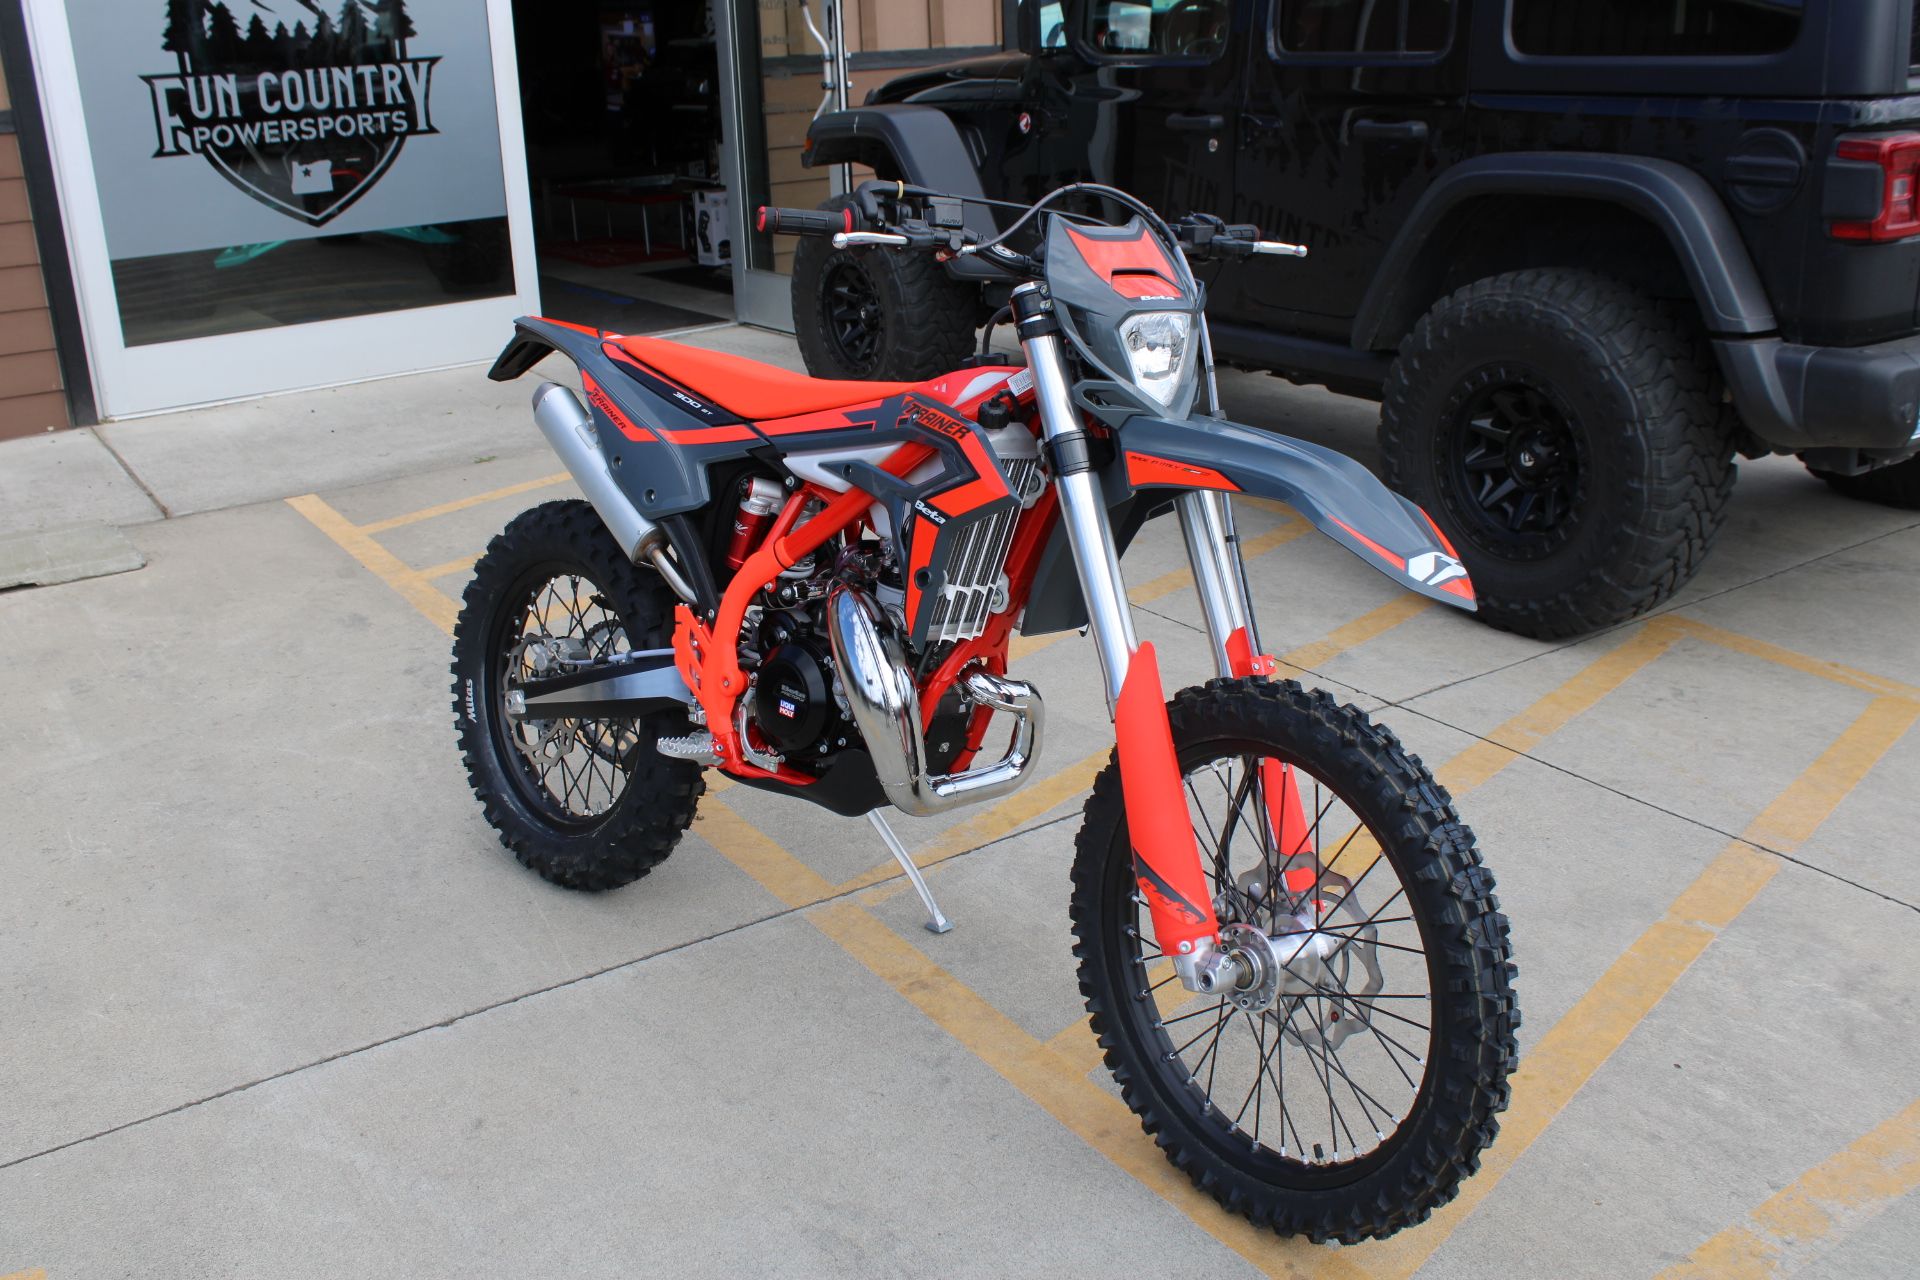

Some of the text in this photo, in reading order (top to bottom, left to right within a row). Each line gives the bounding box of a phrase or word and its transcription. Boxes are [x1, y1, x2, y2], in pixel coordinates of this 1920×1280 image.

[151, 61, 431, 153] FUN COUNTRY
[192, 110, 409, 150] POWERSPORTS
[672, 391, 703, 410] 300
[904, 402, 972, 440] TRAINER
[914, 499, 946, 525] Beta
[465, 678, 478, 723] Mitas
[779, 707, 795, 719] MOLY
[780, 699, 795, 711] LIQUI
